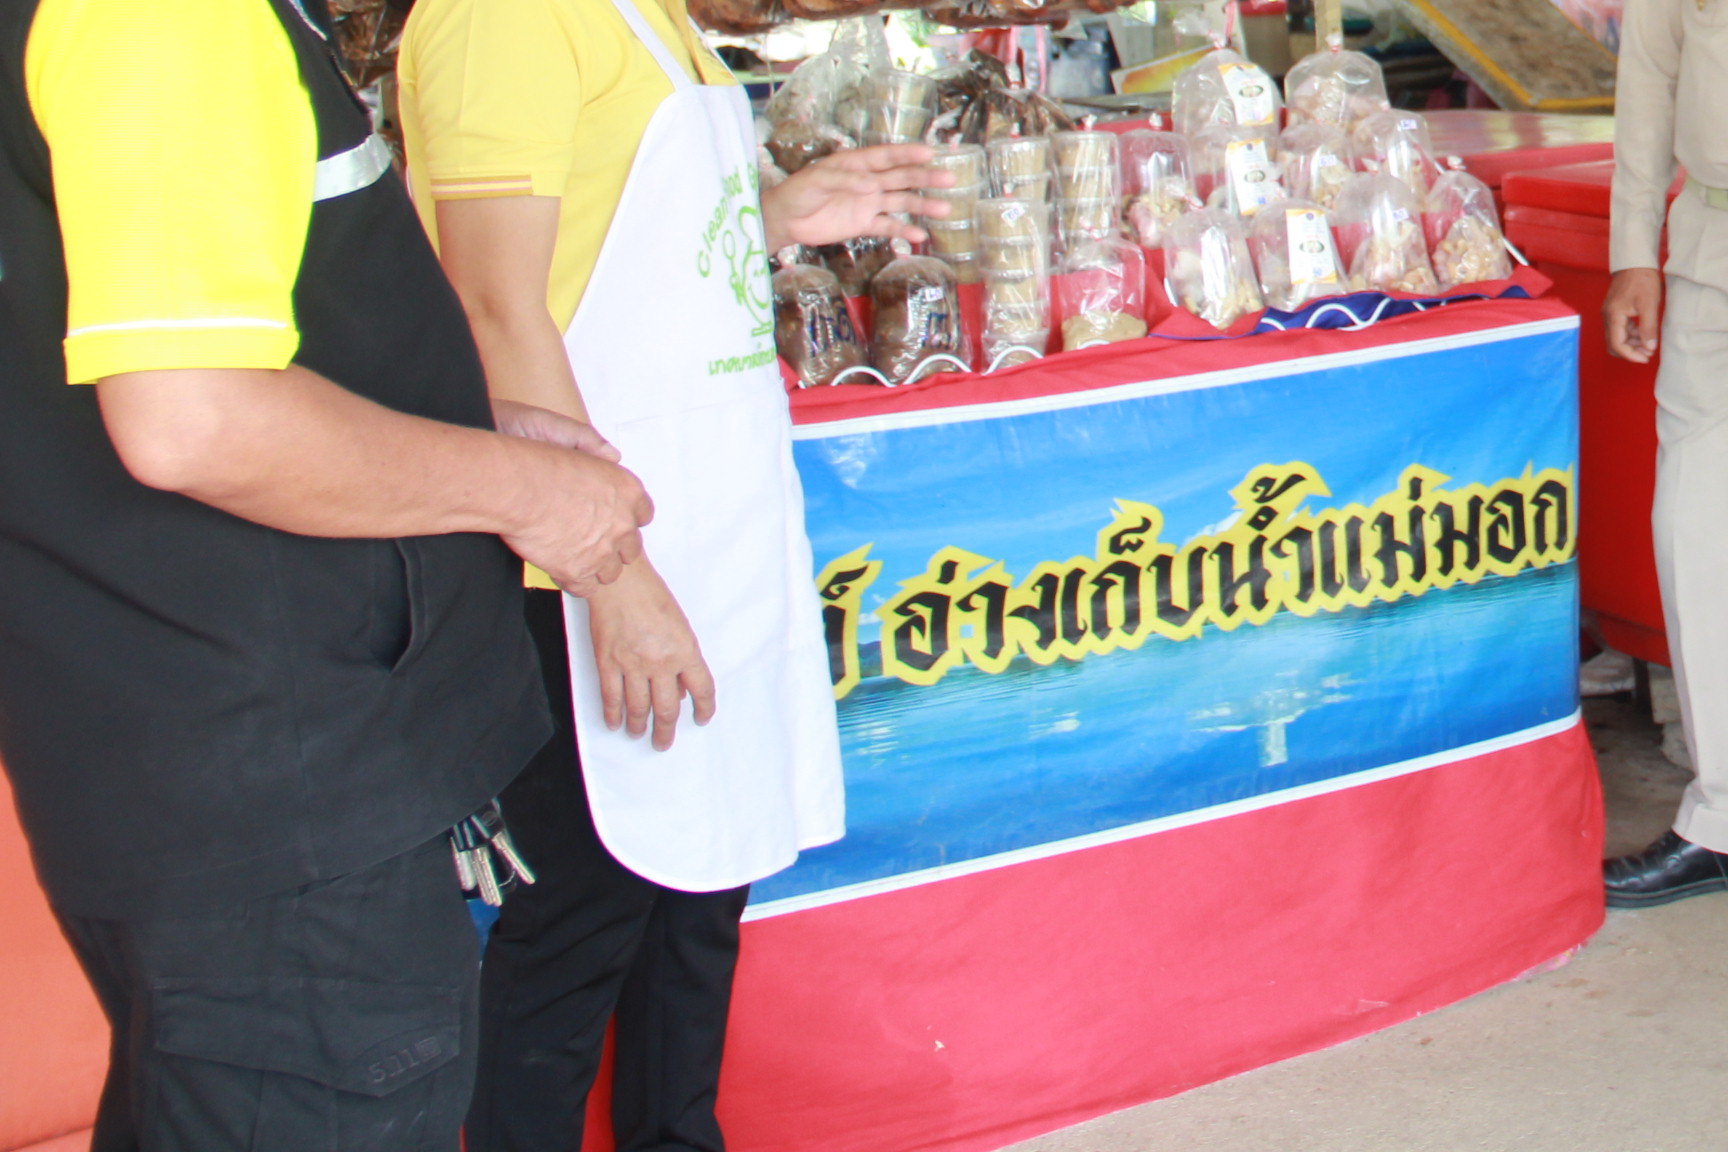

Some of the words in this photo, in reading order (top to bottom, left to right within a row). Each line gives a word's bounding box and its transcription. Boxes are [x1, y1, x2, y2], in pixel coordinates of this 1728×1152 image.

[697, 194, 729, 279] Clean
[892, 472, 1569, 672] อ่างเก็บน้ำแม่มอก
